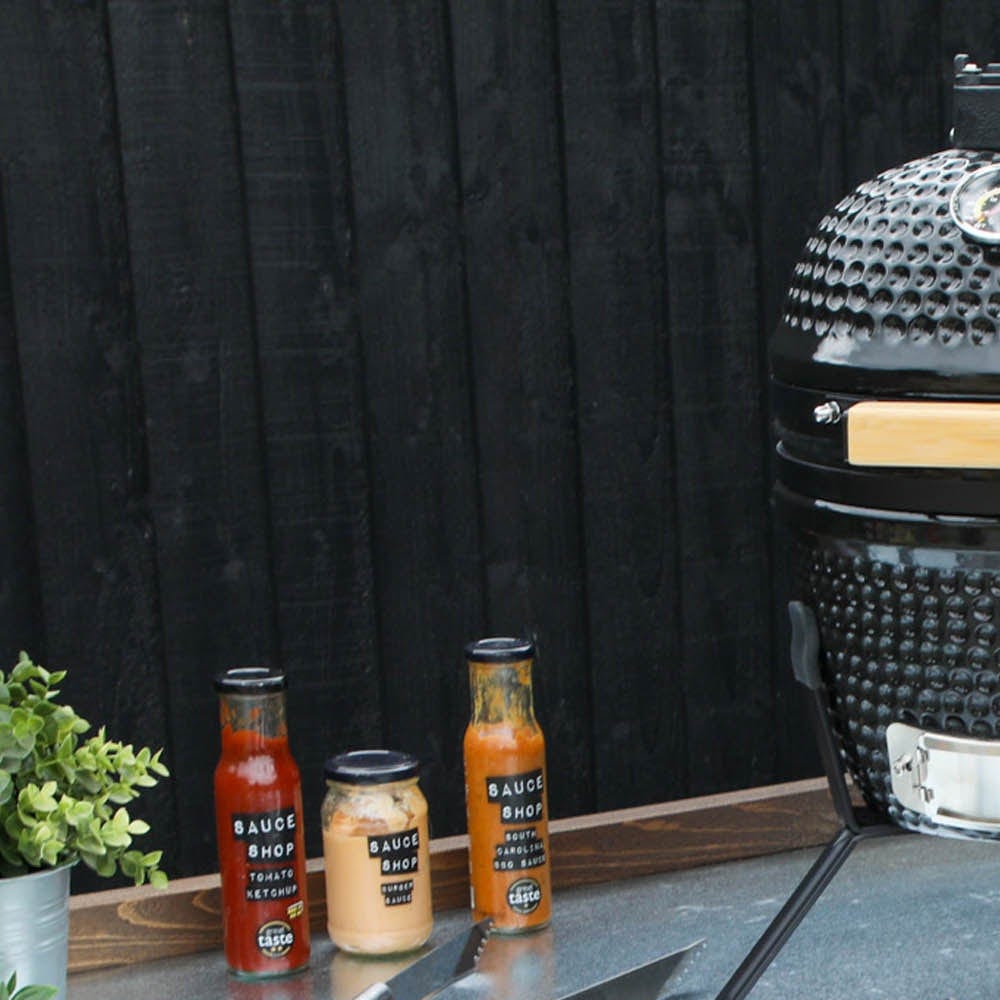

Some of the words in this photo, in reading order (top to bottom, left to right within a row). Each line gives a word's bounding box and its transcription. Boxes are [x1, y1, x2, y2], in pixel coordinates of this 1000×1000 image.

[488, 775, 544, 797] SAUCE
[502, 802, 543, 819] SHOP
[233, 812, 296, 835] SAUCE
[248, 842, 294, 859] SHOP
[369, 832, 419, 853] SAUCE
[382, 856, 418, 872] SHOP
[249, 868, 294, 883] TOMATO
[246, 884, 298, 900] KETCHUP
[508, 889, 541, 905] taste
[258, 932, 294, 948] taste
